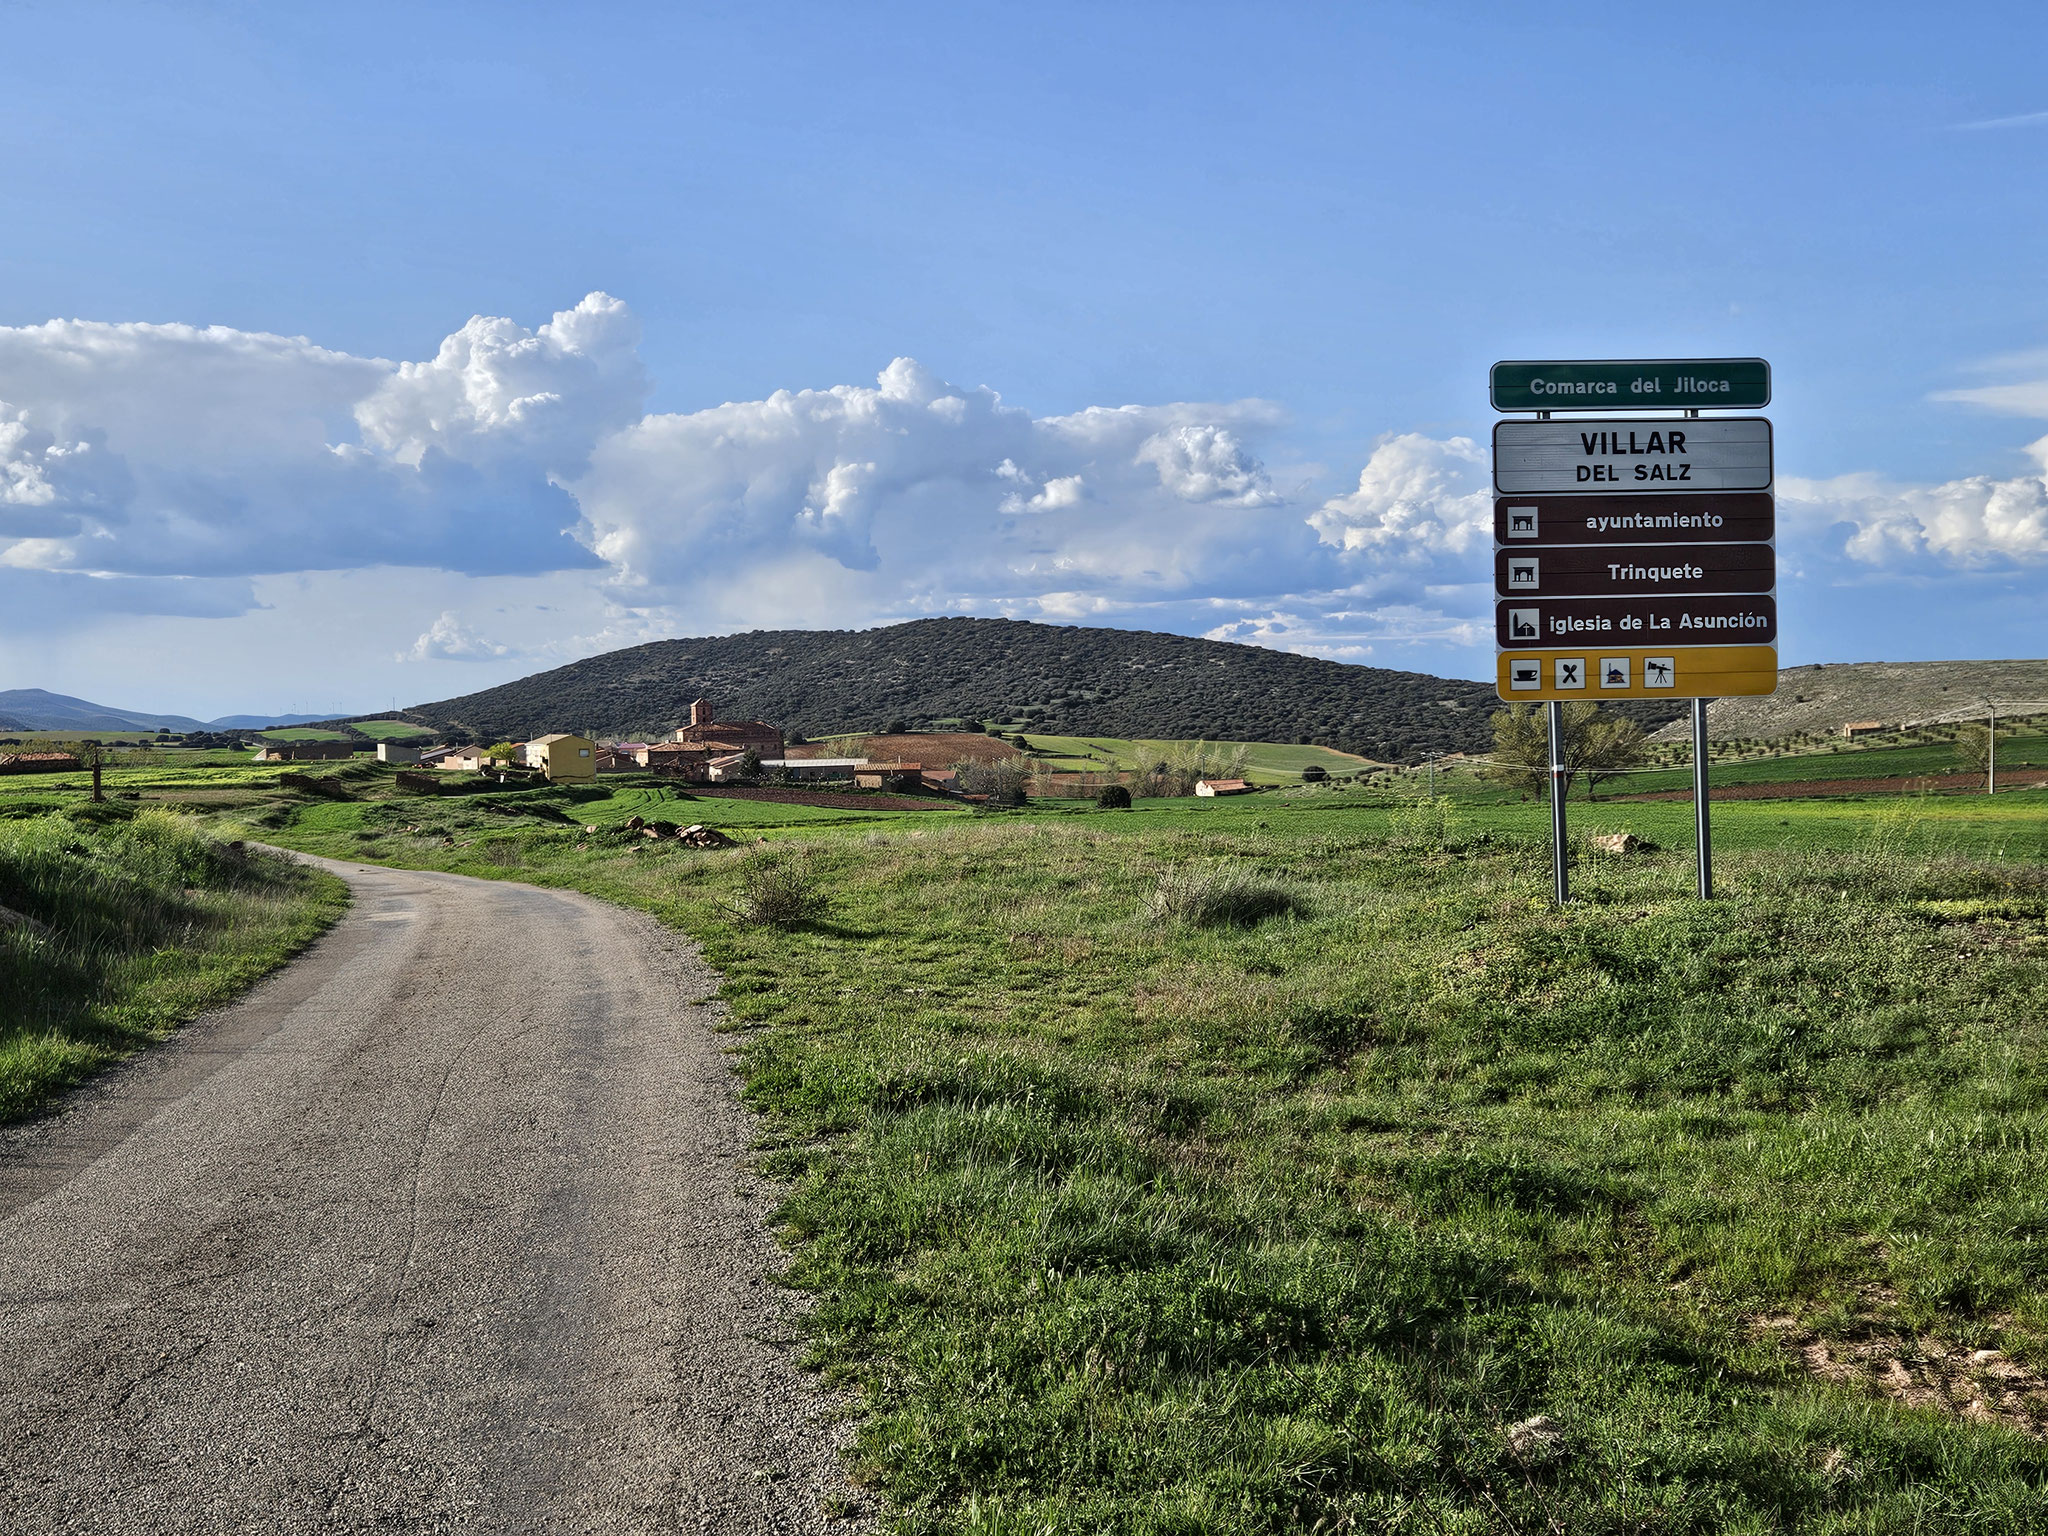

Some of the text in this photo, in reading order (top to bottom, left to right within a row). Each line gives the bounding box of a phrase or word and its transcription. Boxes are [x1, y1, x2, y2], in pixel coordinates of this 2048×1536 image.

[1530, 376, 1731, 395] Comarca del Jiloca
[1581, 431, 1687, 456] VILLAR
[1576, 463, 1692, 482] DEL SALZ
[1586, 511, 1724, 532] ayuntamiento
[1607, 563, 1703, 583] Trinquete
[1549, 611, 1768, 635] iglesia de La Asunción
